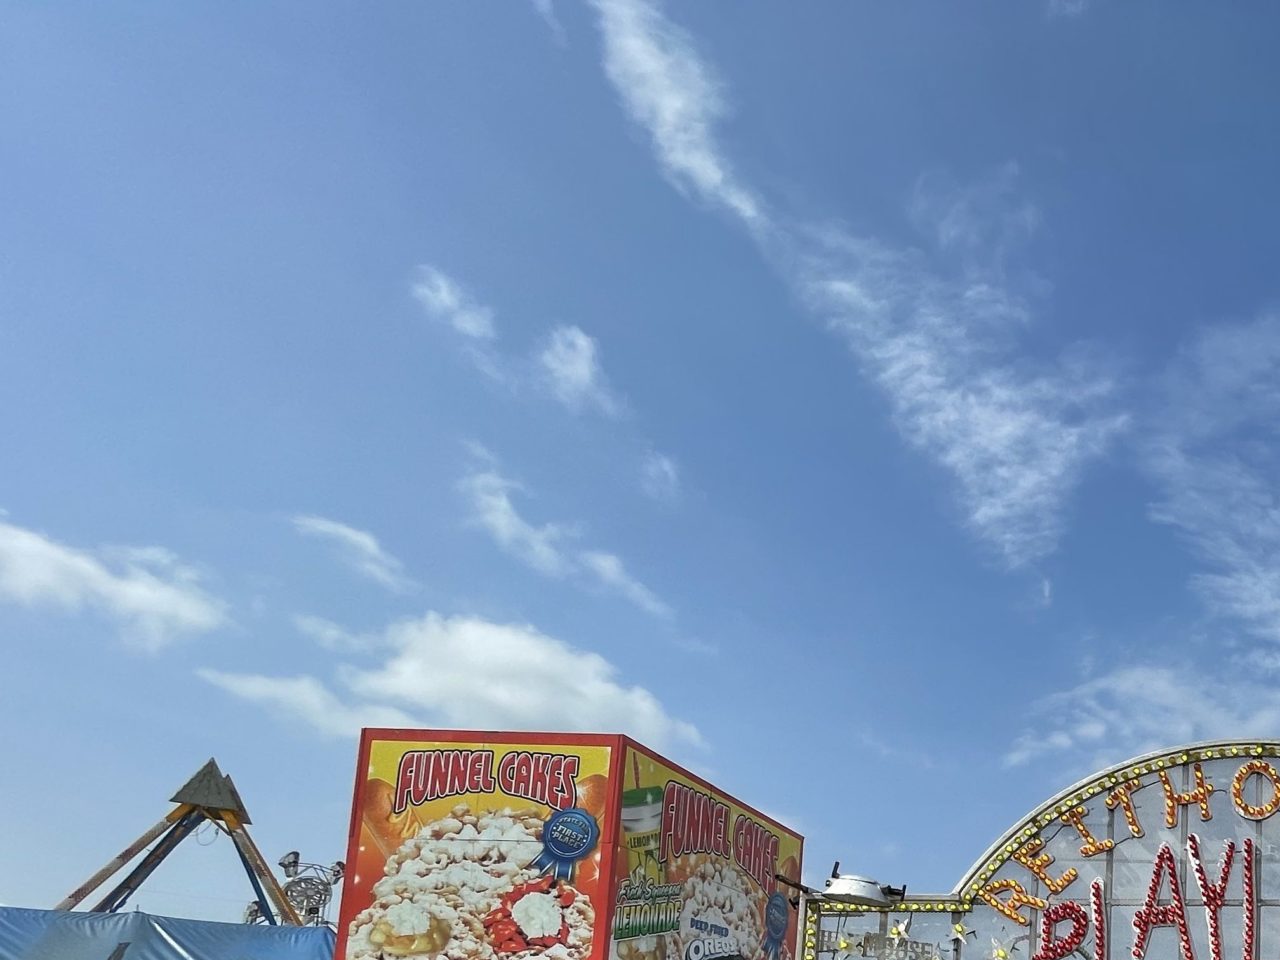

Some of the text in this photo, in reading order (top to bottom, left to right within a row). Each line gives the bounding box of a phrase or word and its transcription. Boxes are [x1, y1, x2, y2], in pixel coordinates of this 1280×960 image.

[394, 749, 580, 814] FUNNEL CAKES
[552, 832, 581, 849] PLACE
[557, 825, 584, 841] FIRST
[659, 780, 780, 900] FUNNEL CAKES
[614, 900, 682, 940] LEMONADE
